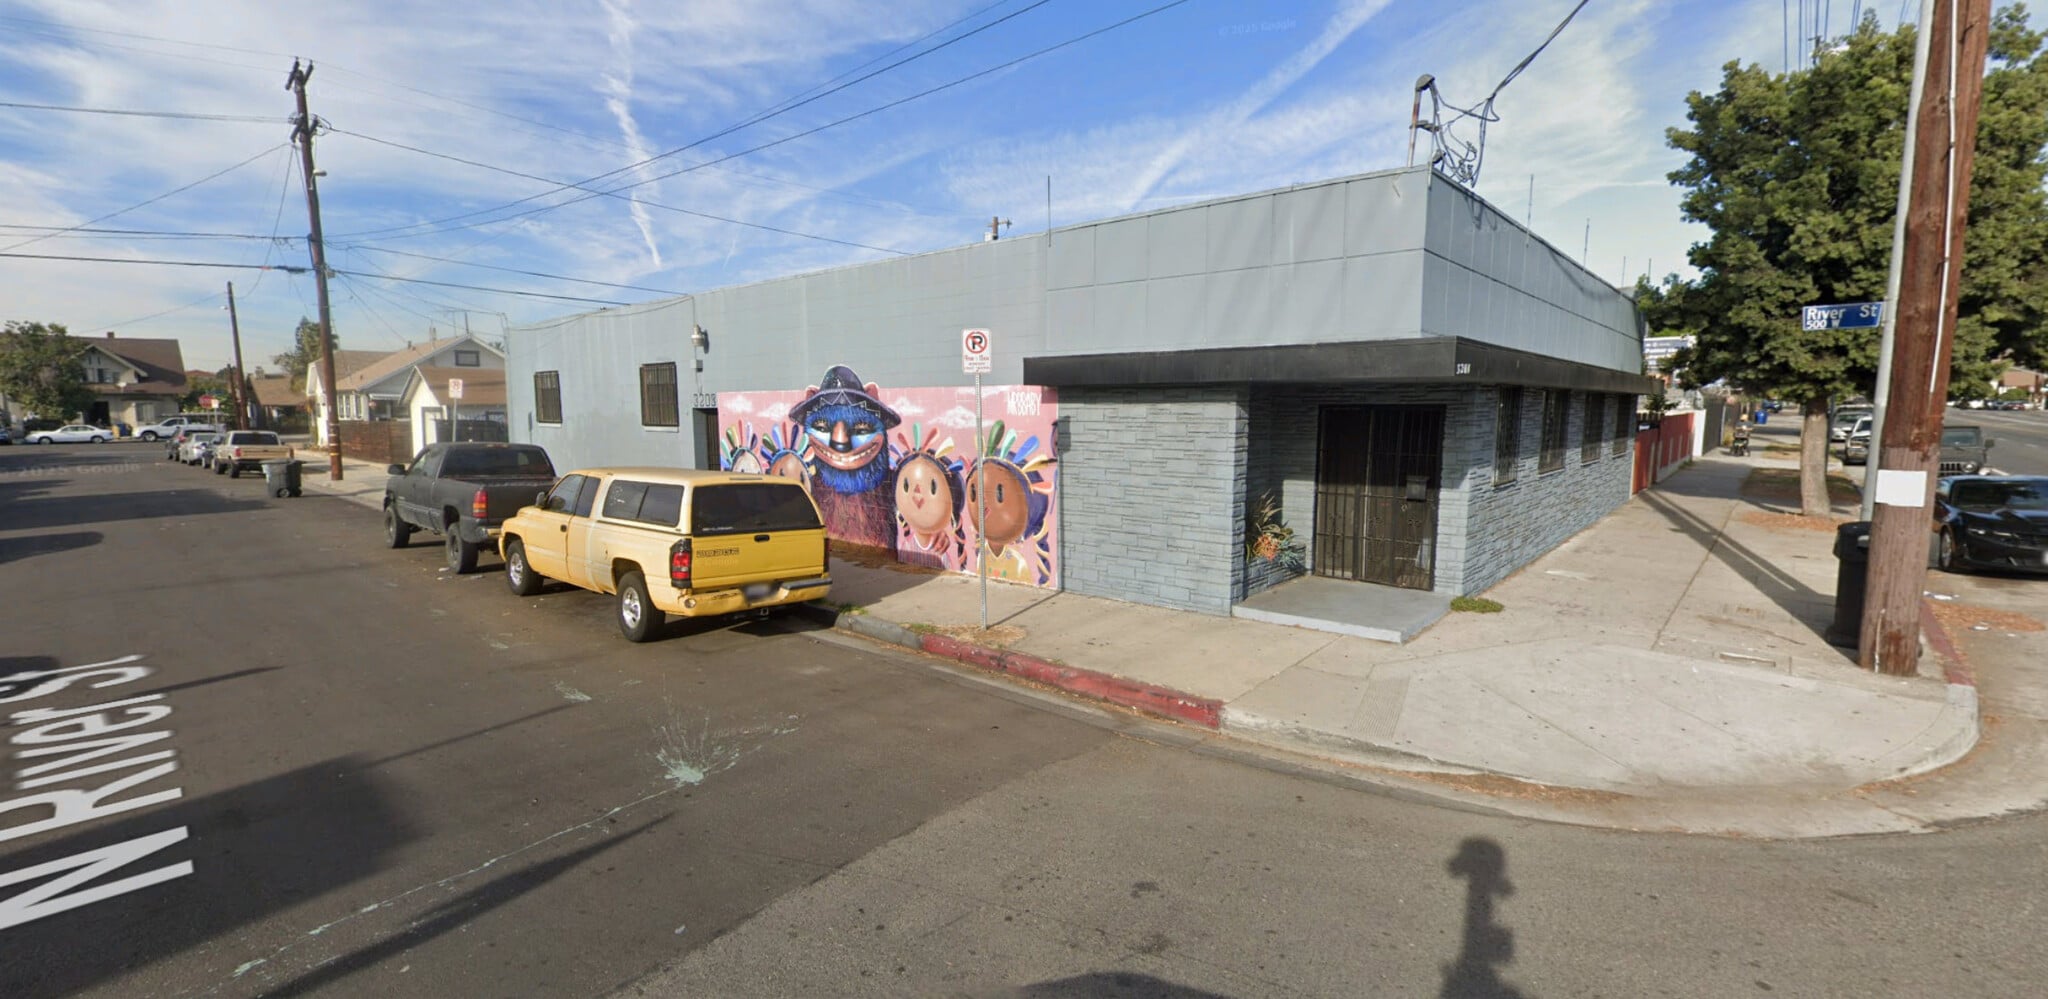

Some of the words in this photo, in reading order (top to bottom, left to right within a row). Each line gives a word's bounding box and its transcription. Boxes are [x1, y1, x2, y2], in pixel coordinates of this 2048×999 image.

[1807, 308, 1846, 320] River
[1859, 304, 1878, 318] St
[1806, 319, 1827, 330] 500
